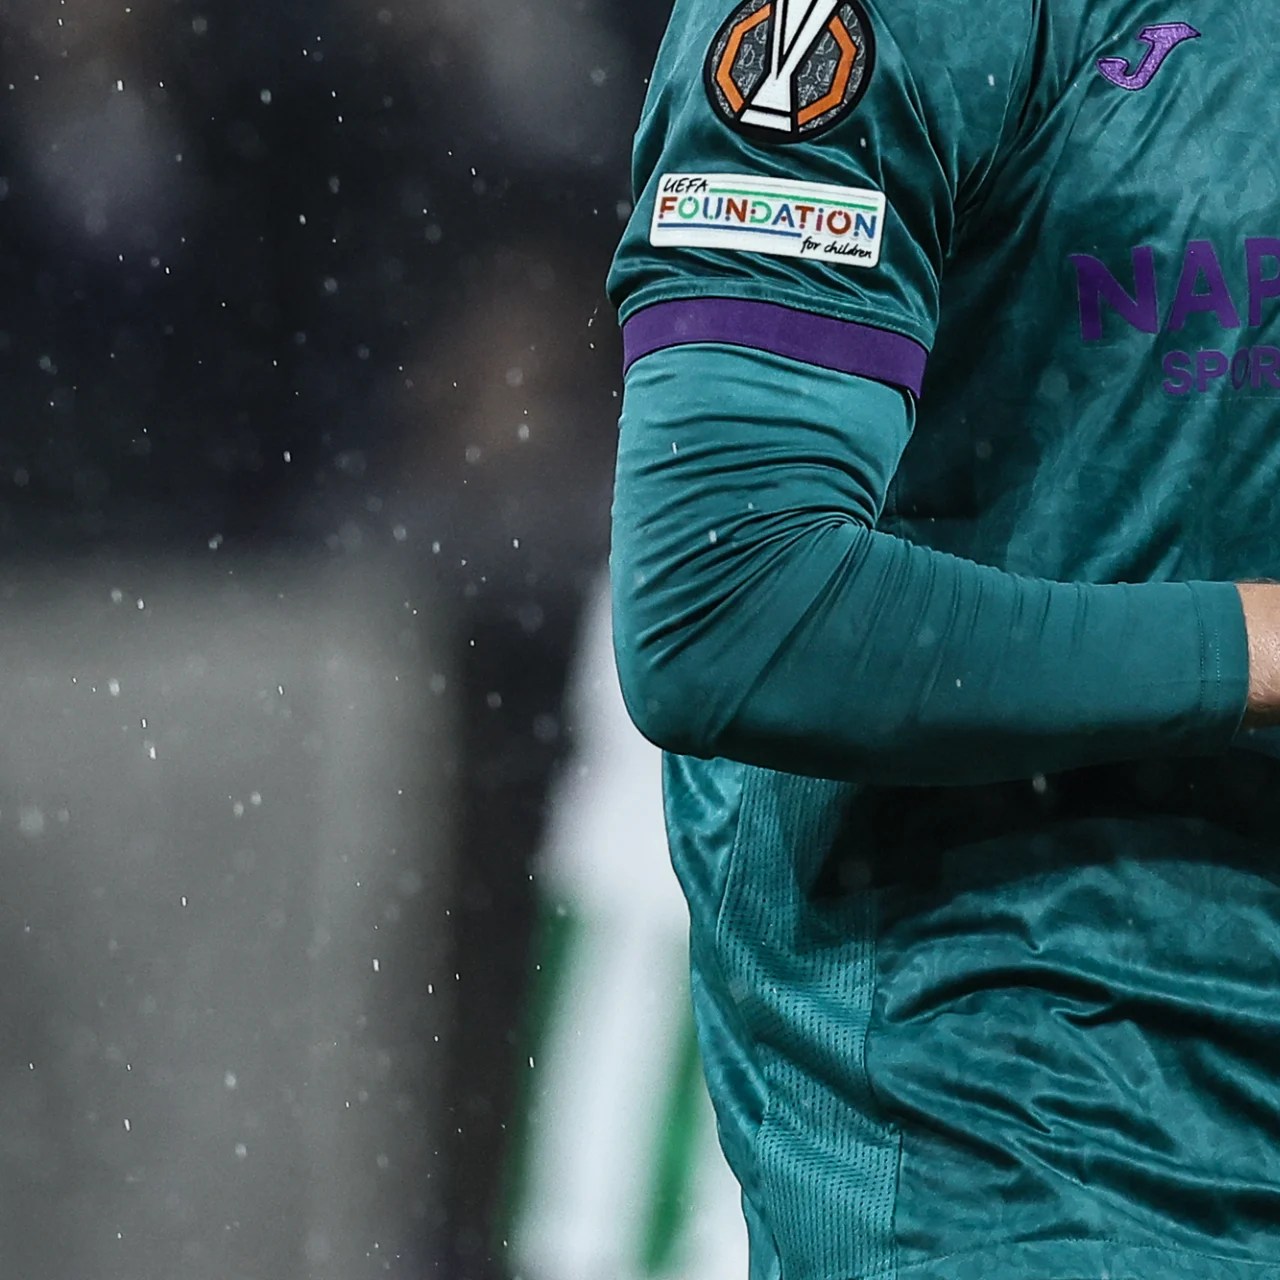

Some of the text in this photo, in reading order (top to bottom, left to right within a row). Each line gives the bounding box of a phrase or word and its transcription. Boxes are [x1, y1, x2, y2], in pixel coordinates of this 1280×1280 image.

[663, 177, 709, 194] UEFA
[658, 195, 878, 240] FOUNDATION
[800, 235, 873, 259] for children
